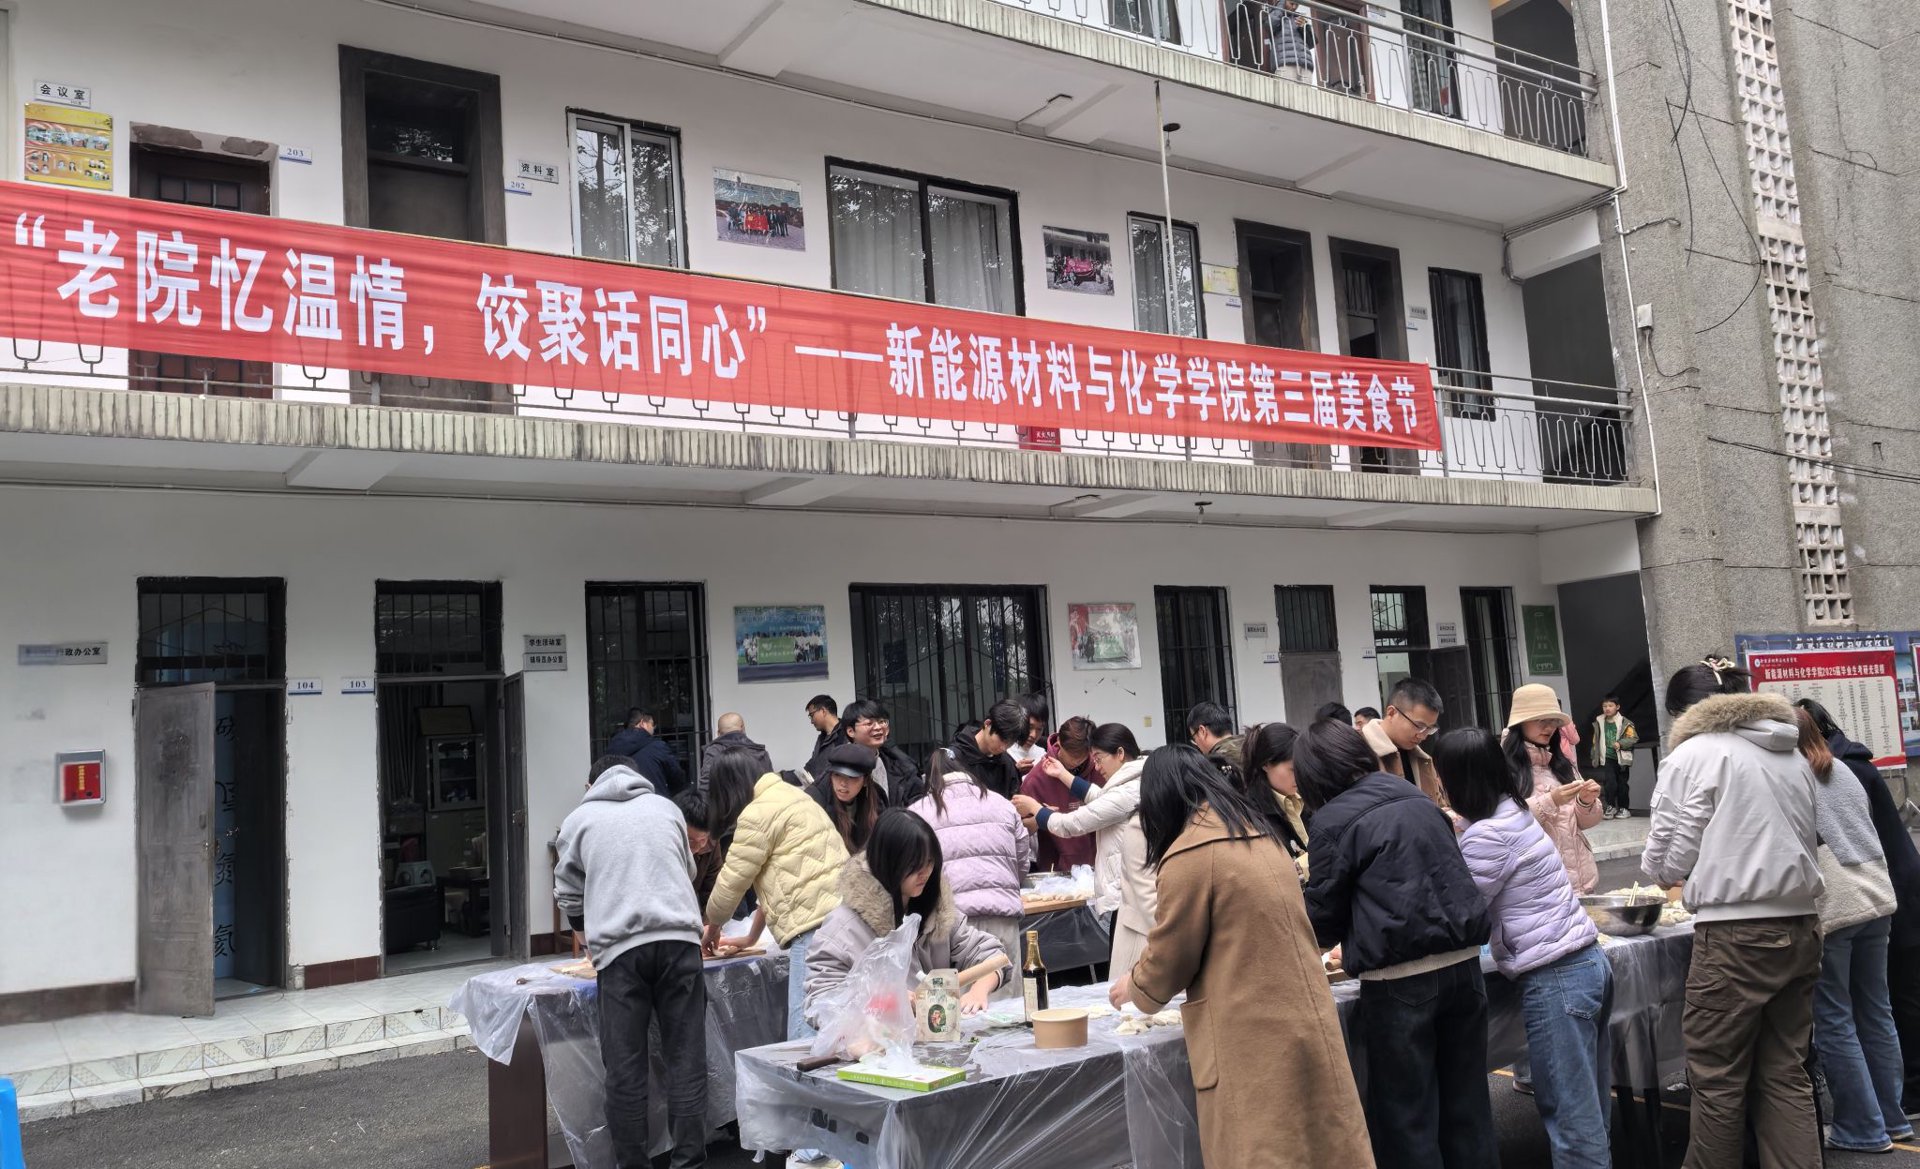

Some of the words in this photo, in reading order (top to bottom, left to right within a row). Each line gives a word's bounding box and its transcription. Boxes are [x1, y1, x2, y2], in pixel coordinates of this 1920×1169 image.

[40, 83, 85, 100] 会议室
[521, 162, 554, 177] 资料室
[297, 681, 314, 689] 104
[350, 680, 367, 688] 103
